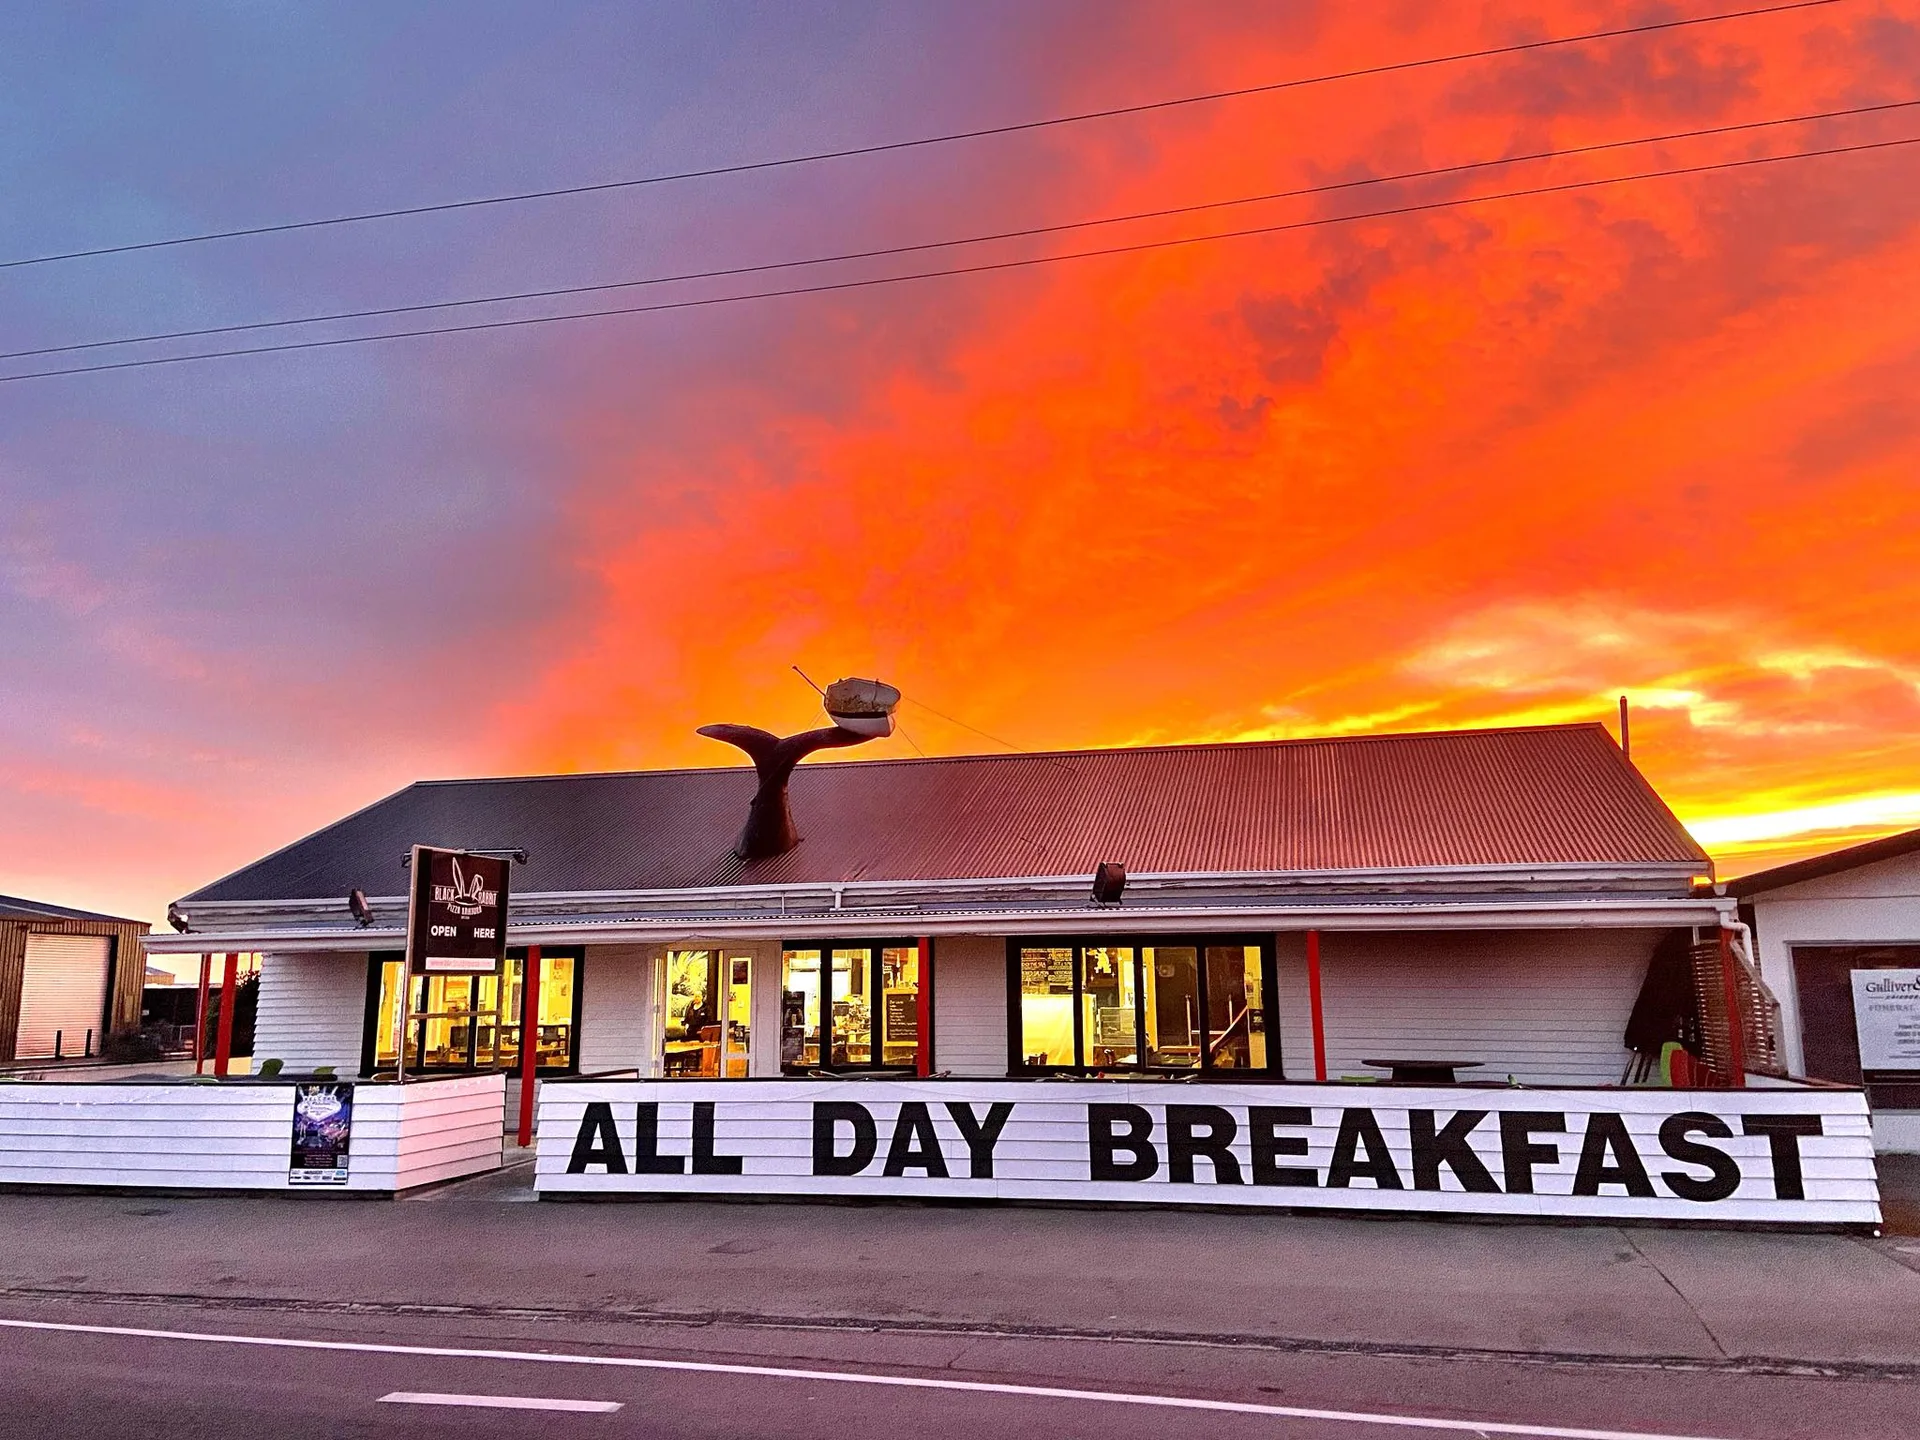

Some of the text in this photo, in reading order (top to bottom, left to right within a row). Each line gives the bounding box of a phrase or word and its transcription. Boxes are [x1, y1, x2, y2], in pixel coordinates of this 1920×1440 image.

[434, 886, 455, 902] BLACK
[446, 902, 461, 914] PIZZA
[430, 925, 496, 939] OPEN HERE
[1865, 978, 1913, 993] Gulliver
[565, 1101, 1823, 1201] ALL DAY BREAKFAST
